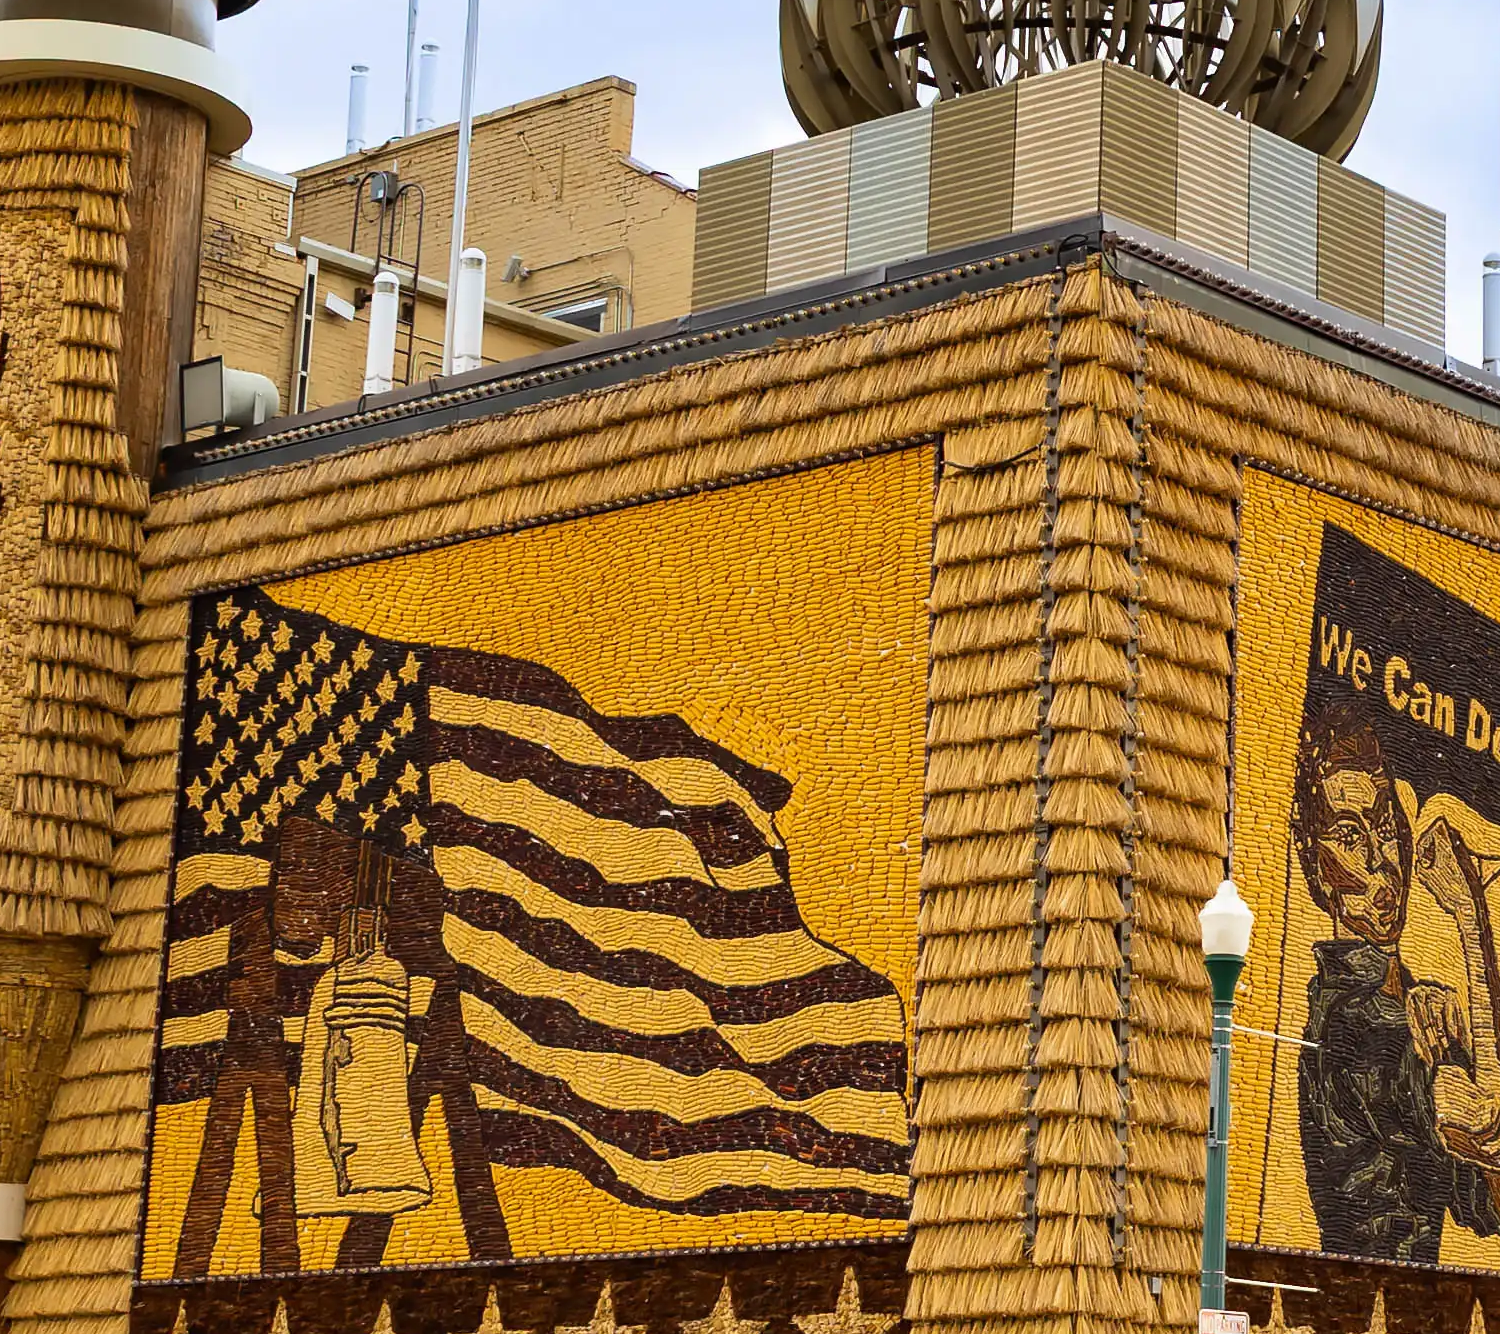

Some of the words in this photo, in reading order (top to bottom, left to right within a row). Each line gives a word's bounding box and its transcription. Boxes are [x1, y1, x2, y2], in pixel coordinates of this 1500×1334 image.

[1318, 613, 1372, 691] We
[1383, 656, 1456, 737] Can
[1216, 1318, 1245, 1334] PARKING
